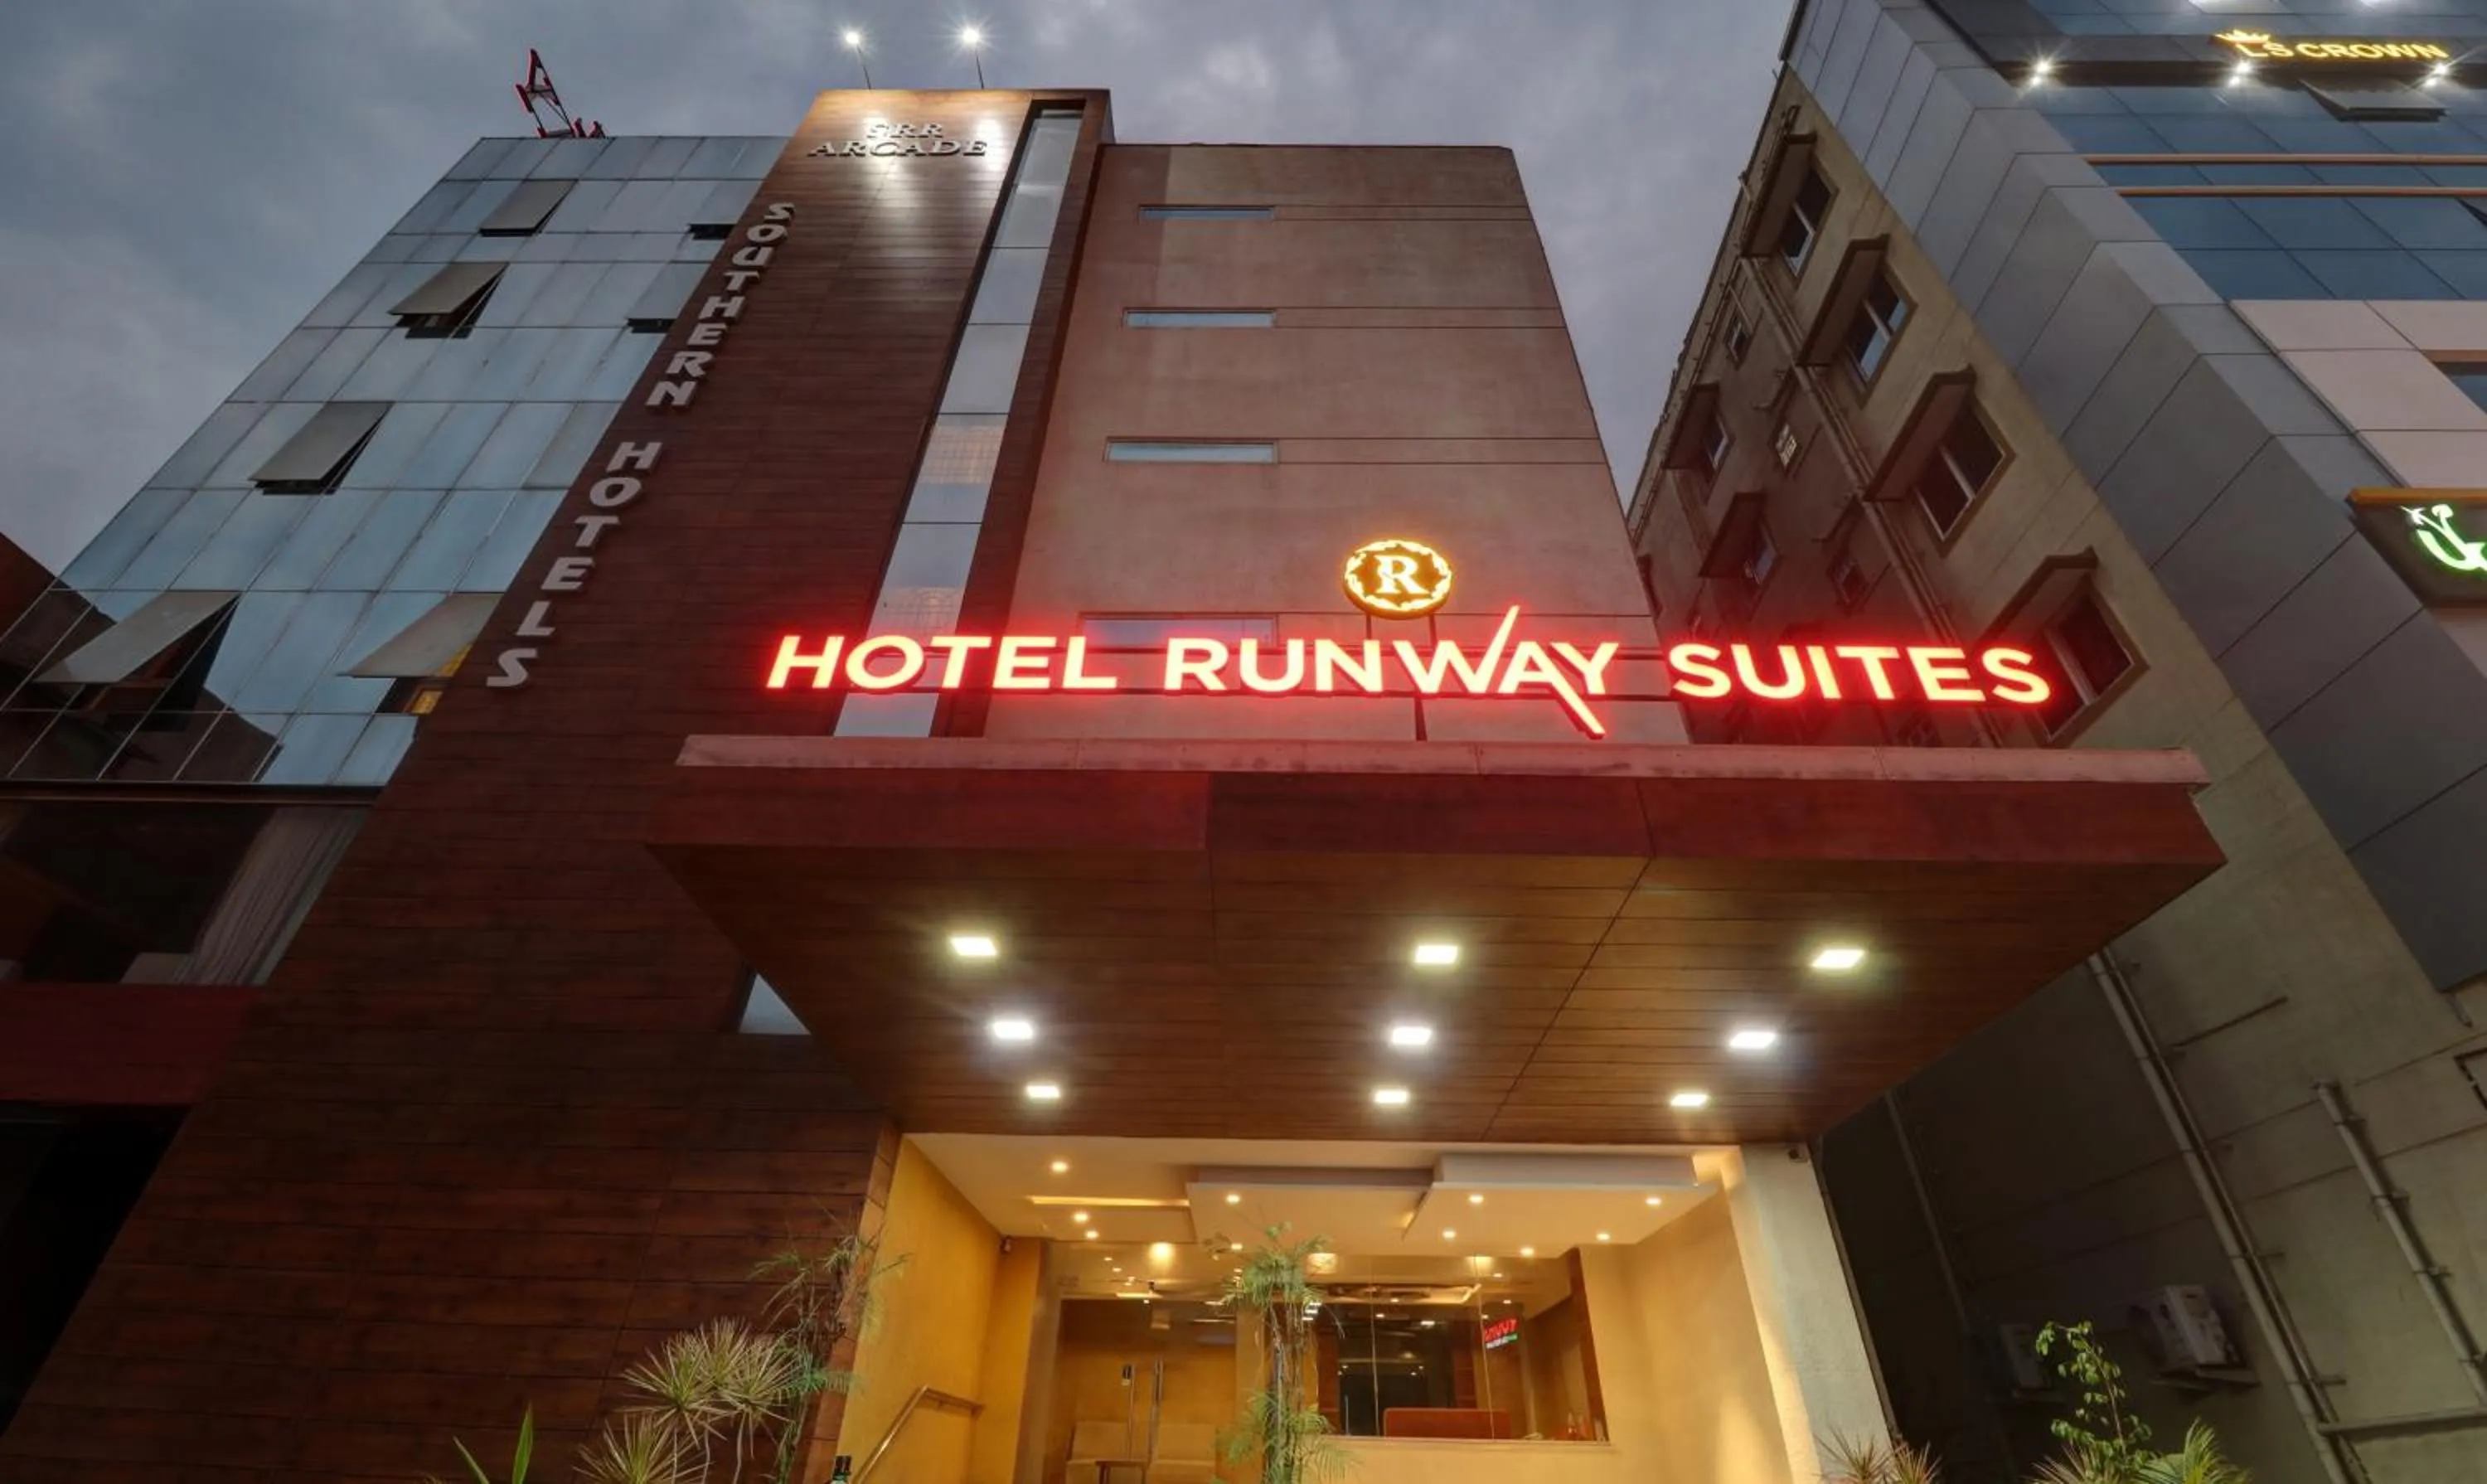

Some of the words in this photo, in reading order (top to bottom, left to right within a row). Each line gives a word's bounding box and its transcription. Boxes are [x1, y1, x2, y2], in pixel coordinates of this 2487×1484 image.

[2236, 42, 2294, 57] LS
[2296, 43, 2450, 59] CROWN
[807, 140, 987, 157] ARCADE
[645, 202, 796, 407] SOUTHERN
[486, 441, 663, 688] HOTELS
[1374, 554, 1431, 595] R
[766, 635, 1118, 689] HOTEL
[1164, 605, 1620, 736] RUNWAY
[1668, 643, 2051, 704] SUITES
